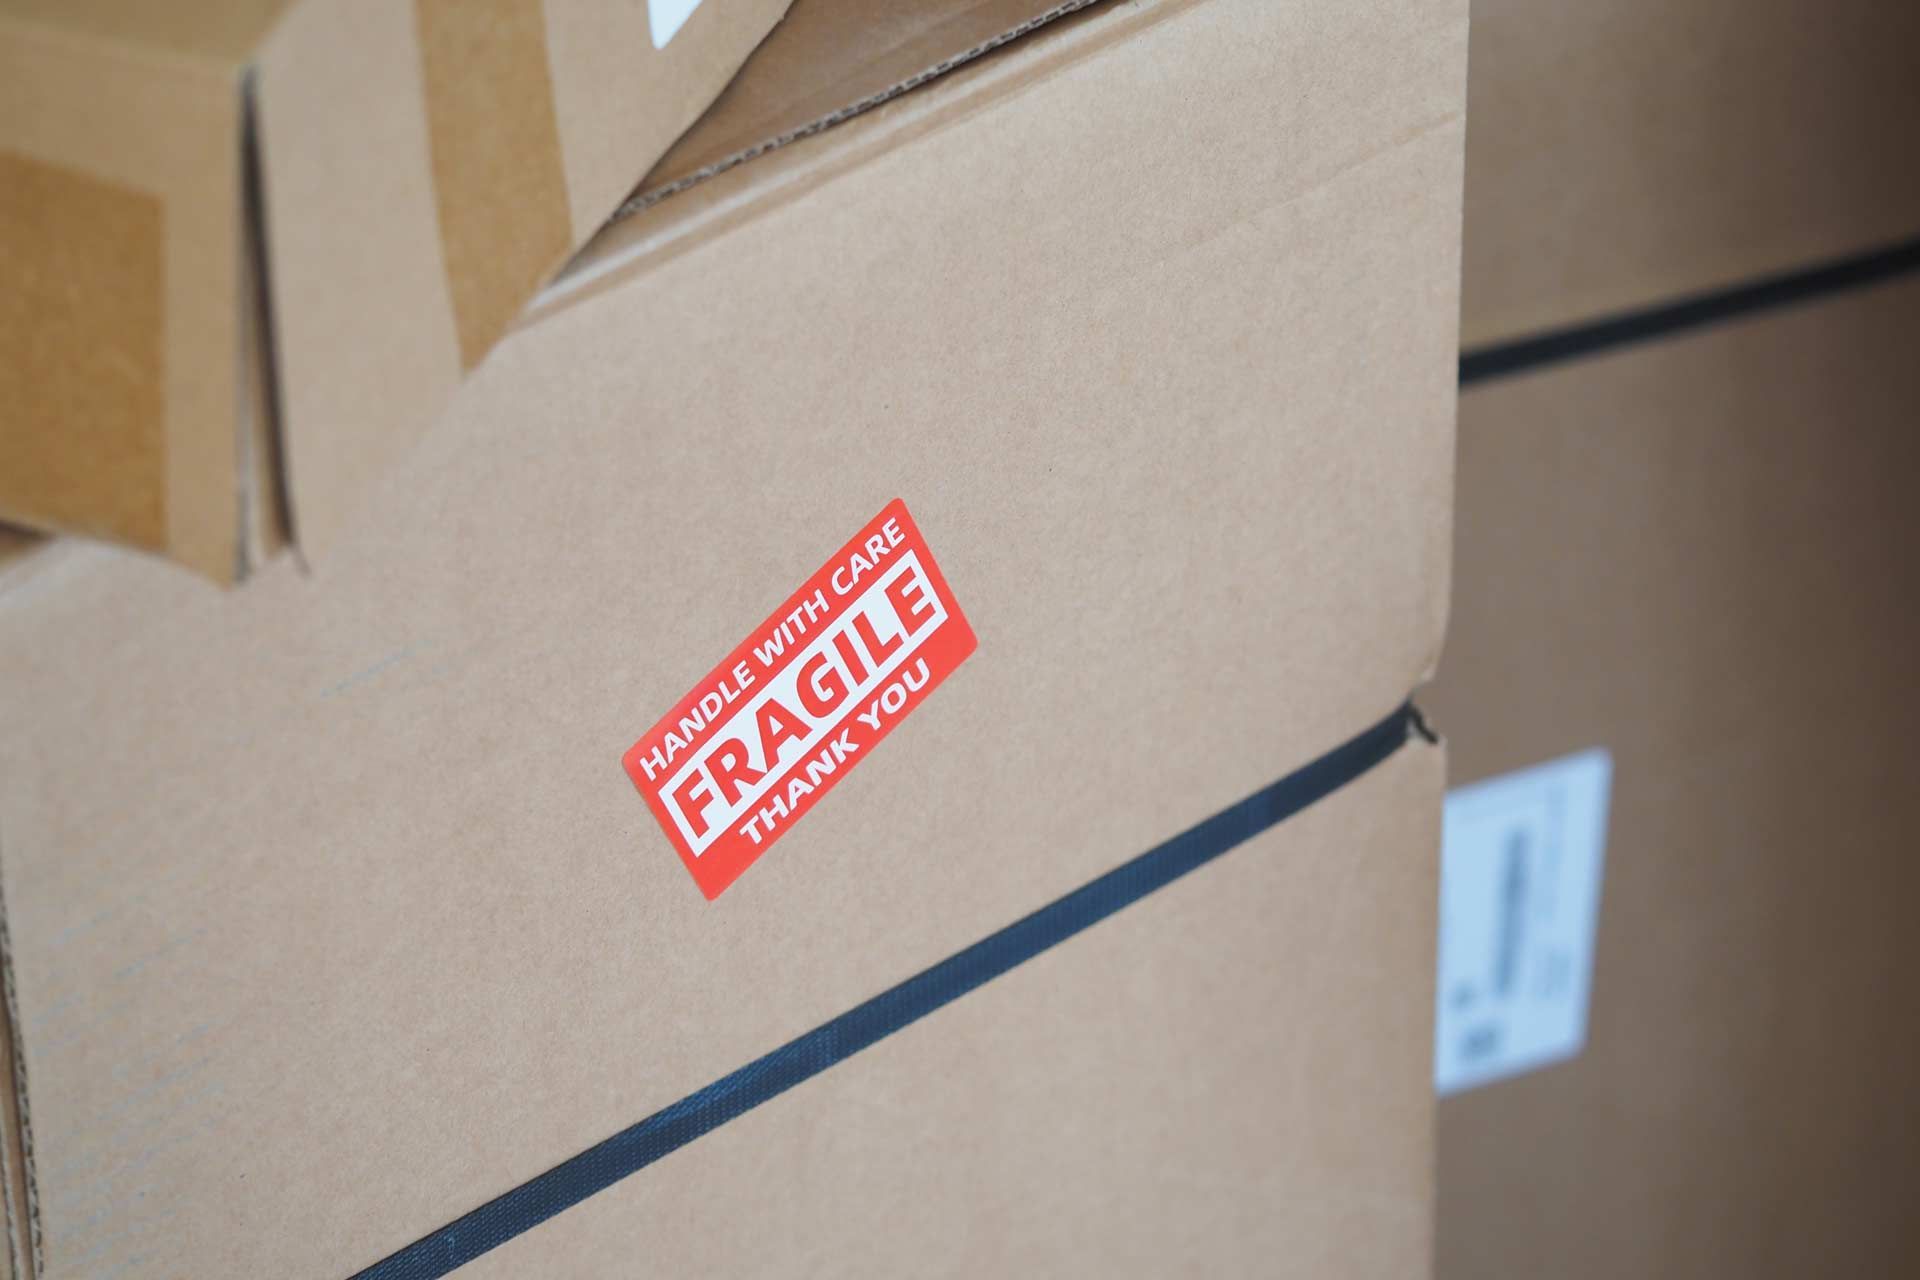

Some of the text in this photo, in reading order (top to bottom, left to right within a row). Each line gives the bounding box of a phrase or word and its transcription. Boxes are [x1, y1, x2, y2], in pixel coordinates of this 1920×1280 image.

[639, 517, 906, 781] HANDLE WITH CARE
[671, 565, 937, 839] FRAGILE
[739, 657, 931, 845] THANK YOU
